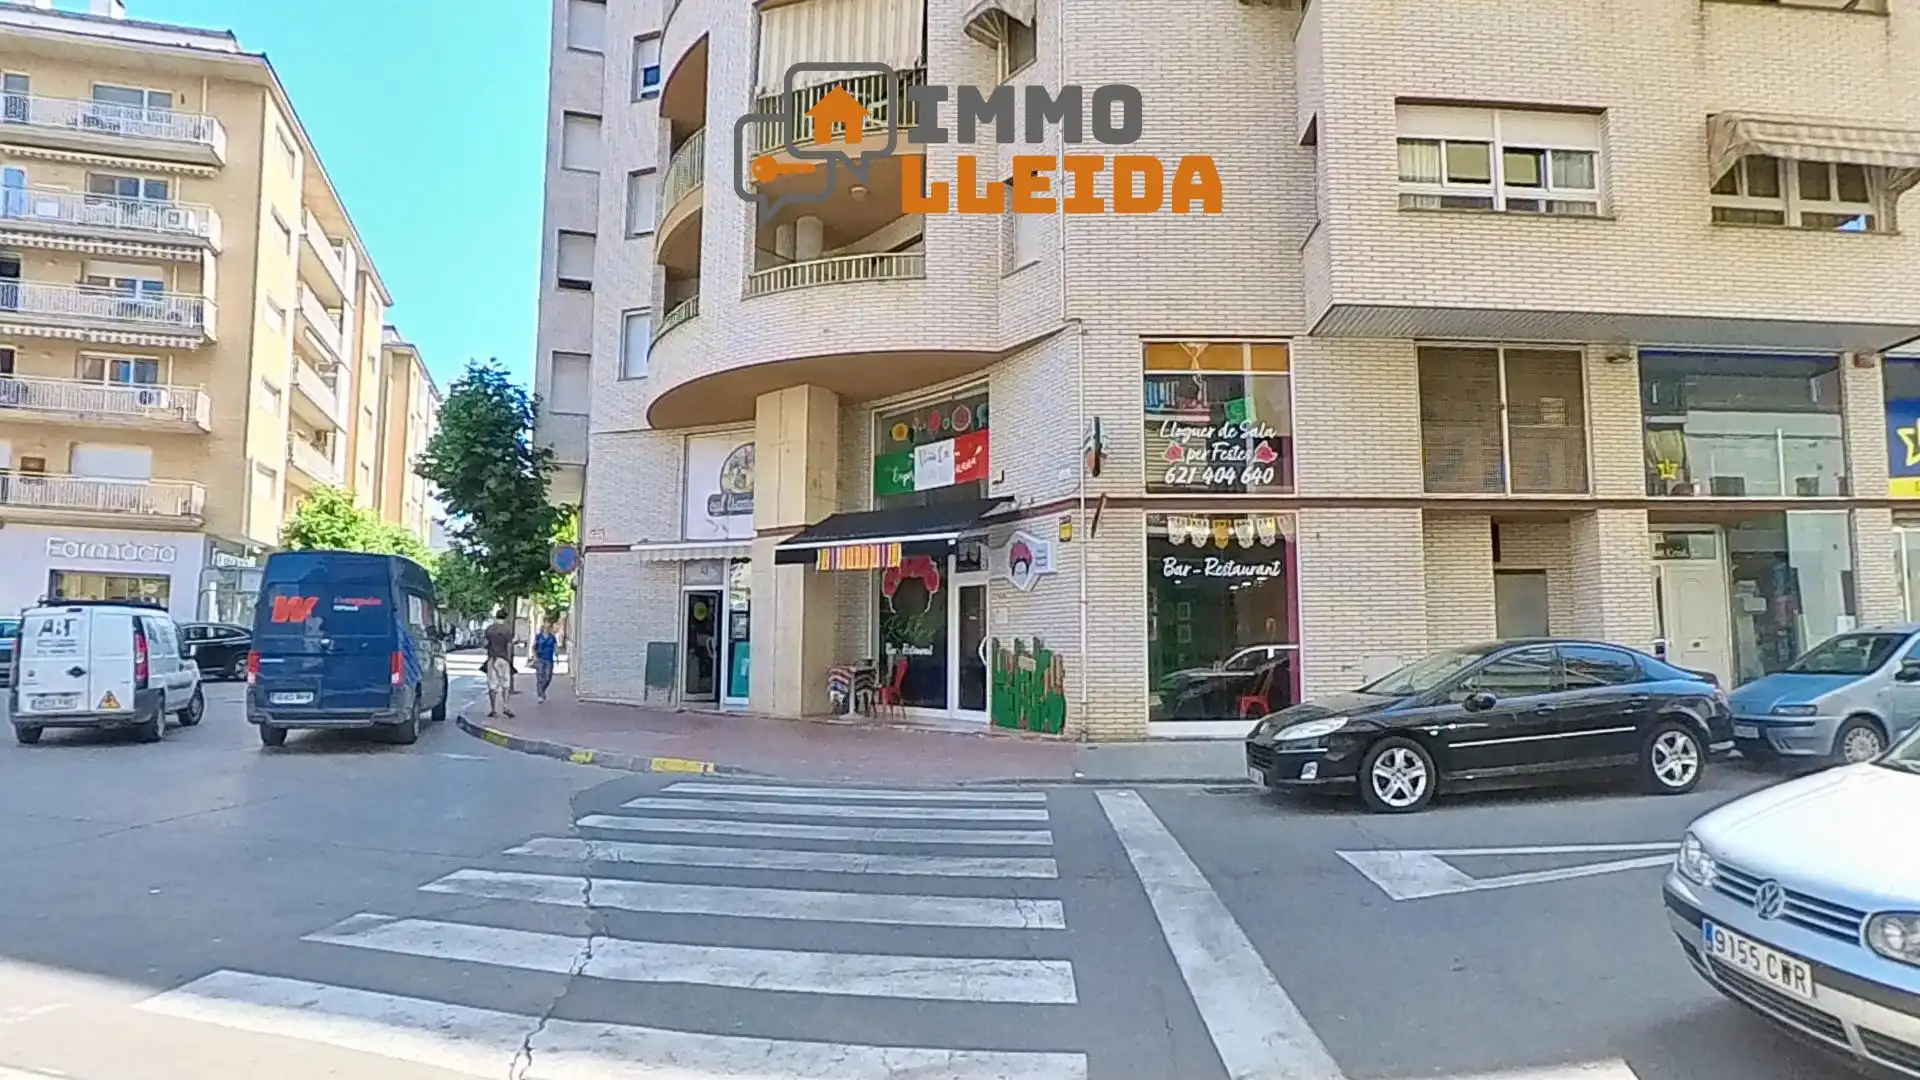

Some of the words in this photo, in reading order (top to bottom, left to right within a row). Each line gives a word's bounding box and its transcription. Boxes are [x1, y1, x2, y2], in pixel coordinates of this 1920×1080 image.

[1160, 419, 1215, 443] Lloguer
[1218, 421, 1238, 438] de
[1240, 420, 1276, 438] Sala
[1186, 447, 1208, 464] per
[1165, 466, 1196, 484] 621
[1202, 466, 1236, 485] 404
[1241, 466, 1274, 484] 640
[1715, 929, 1760, 971] 9155
